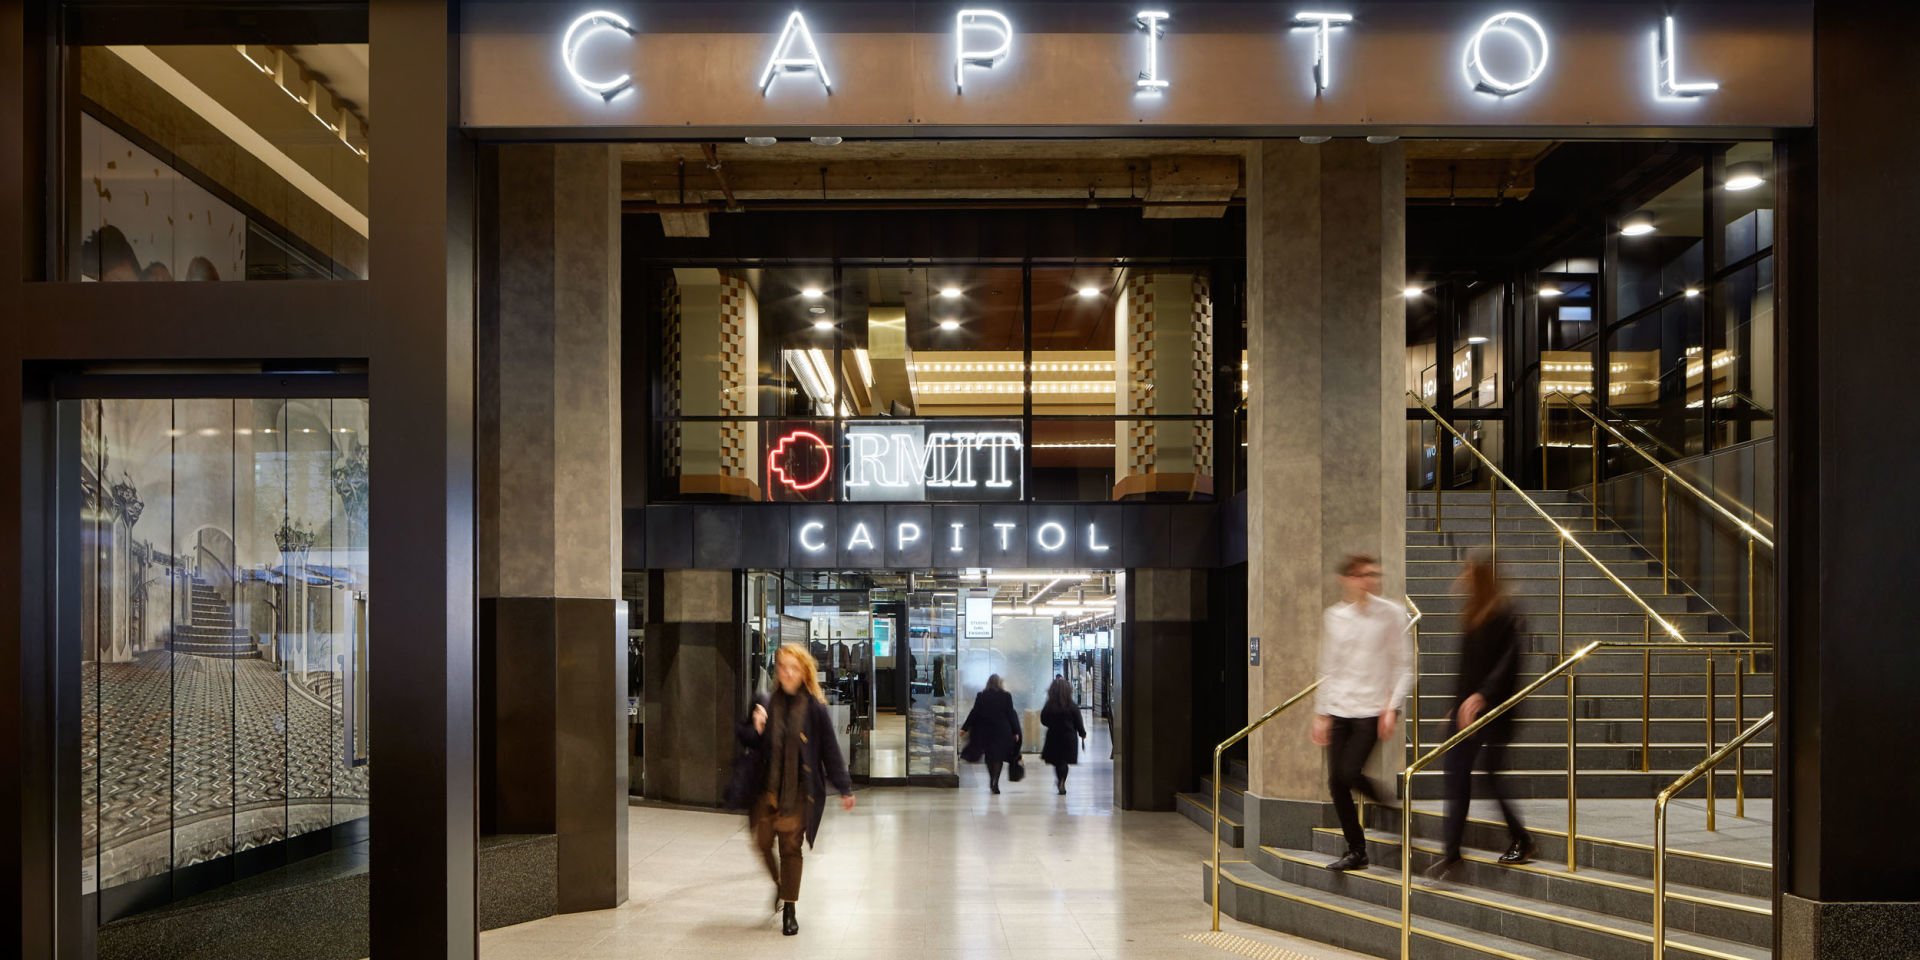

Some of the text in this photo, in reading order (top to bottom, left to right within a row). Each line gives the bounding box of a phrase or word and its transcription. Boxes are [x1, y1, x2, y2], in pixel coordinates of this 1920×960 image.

[562, 9, 1719, 94] CAPITOL
[844, 432, 1021, 488] RMIT
[800, 521, 1110, 552] CAPITOL
